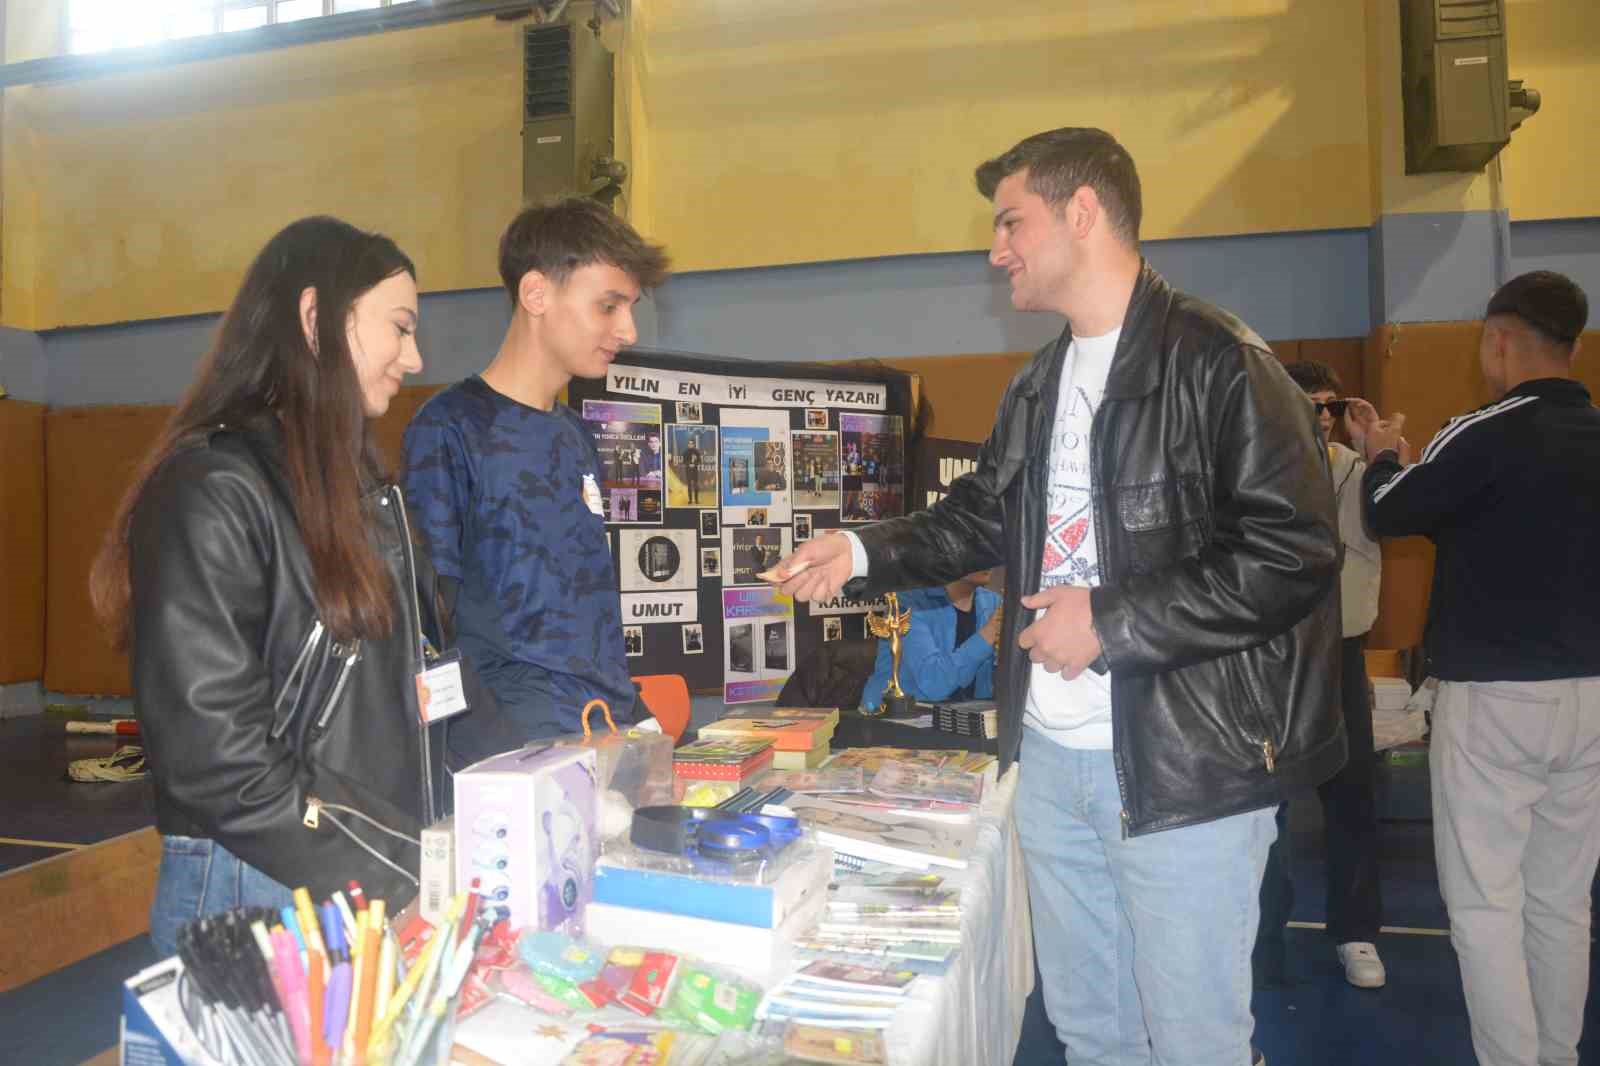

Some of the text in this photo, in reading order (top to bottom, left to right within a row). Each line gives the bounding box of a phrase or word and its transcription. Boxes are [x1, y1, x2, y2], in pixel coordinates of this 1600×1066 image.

[613, 375, 880, 405] YILIN EN İYİ GENÇ YAZARI
[631, 602, 684, 617] UMUT
